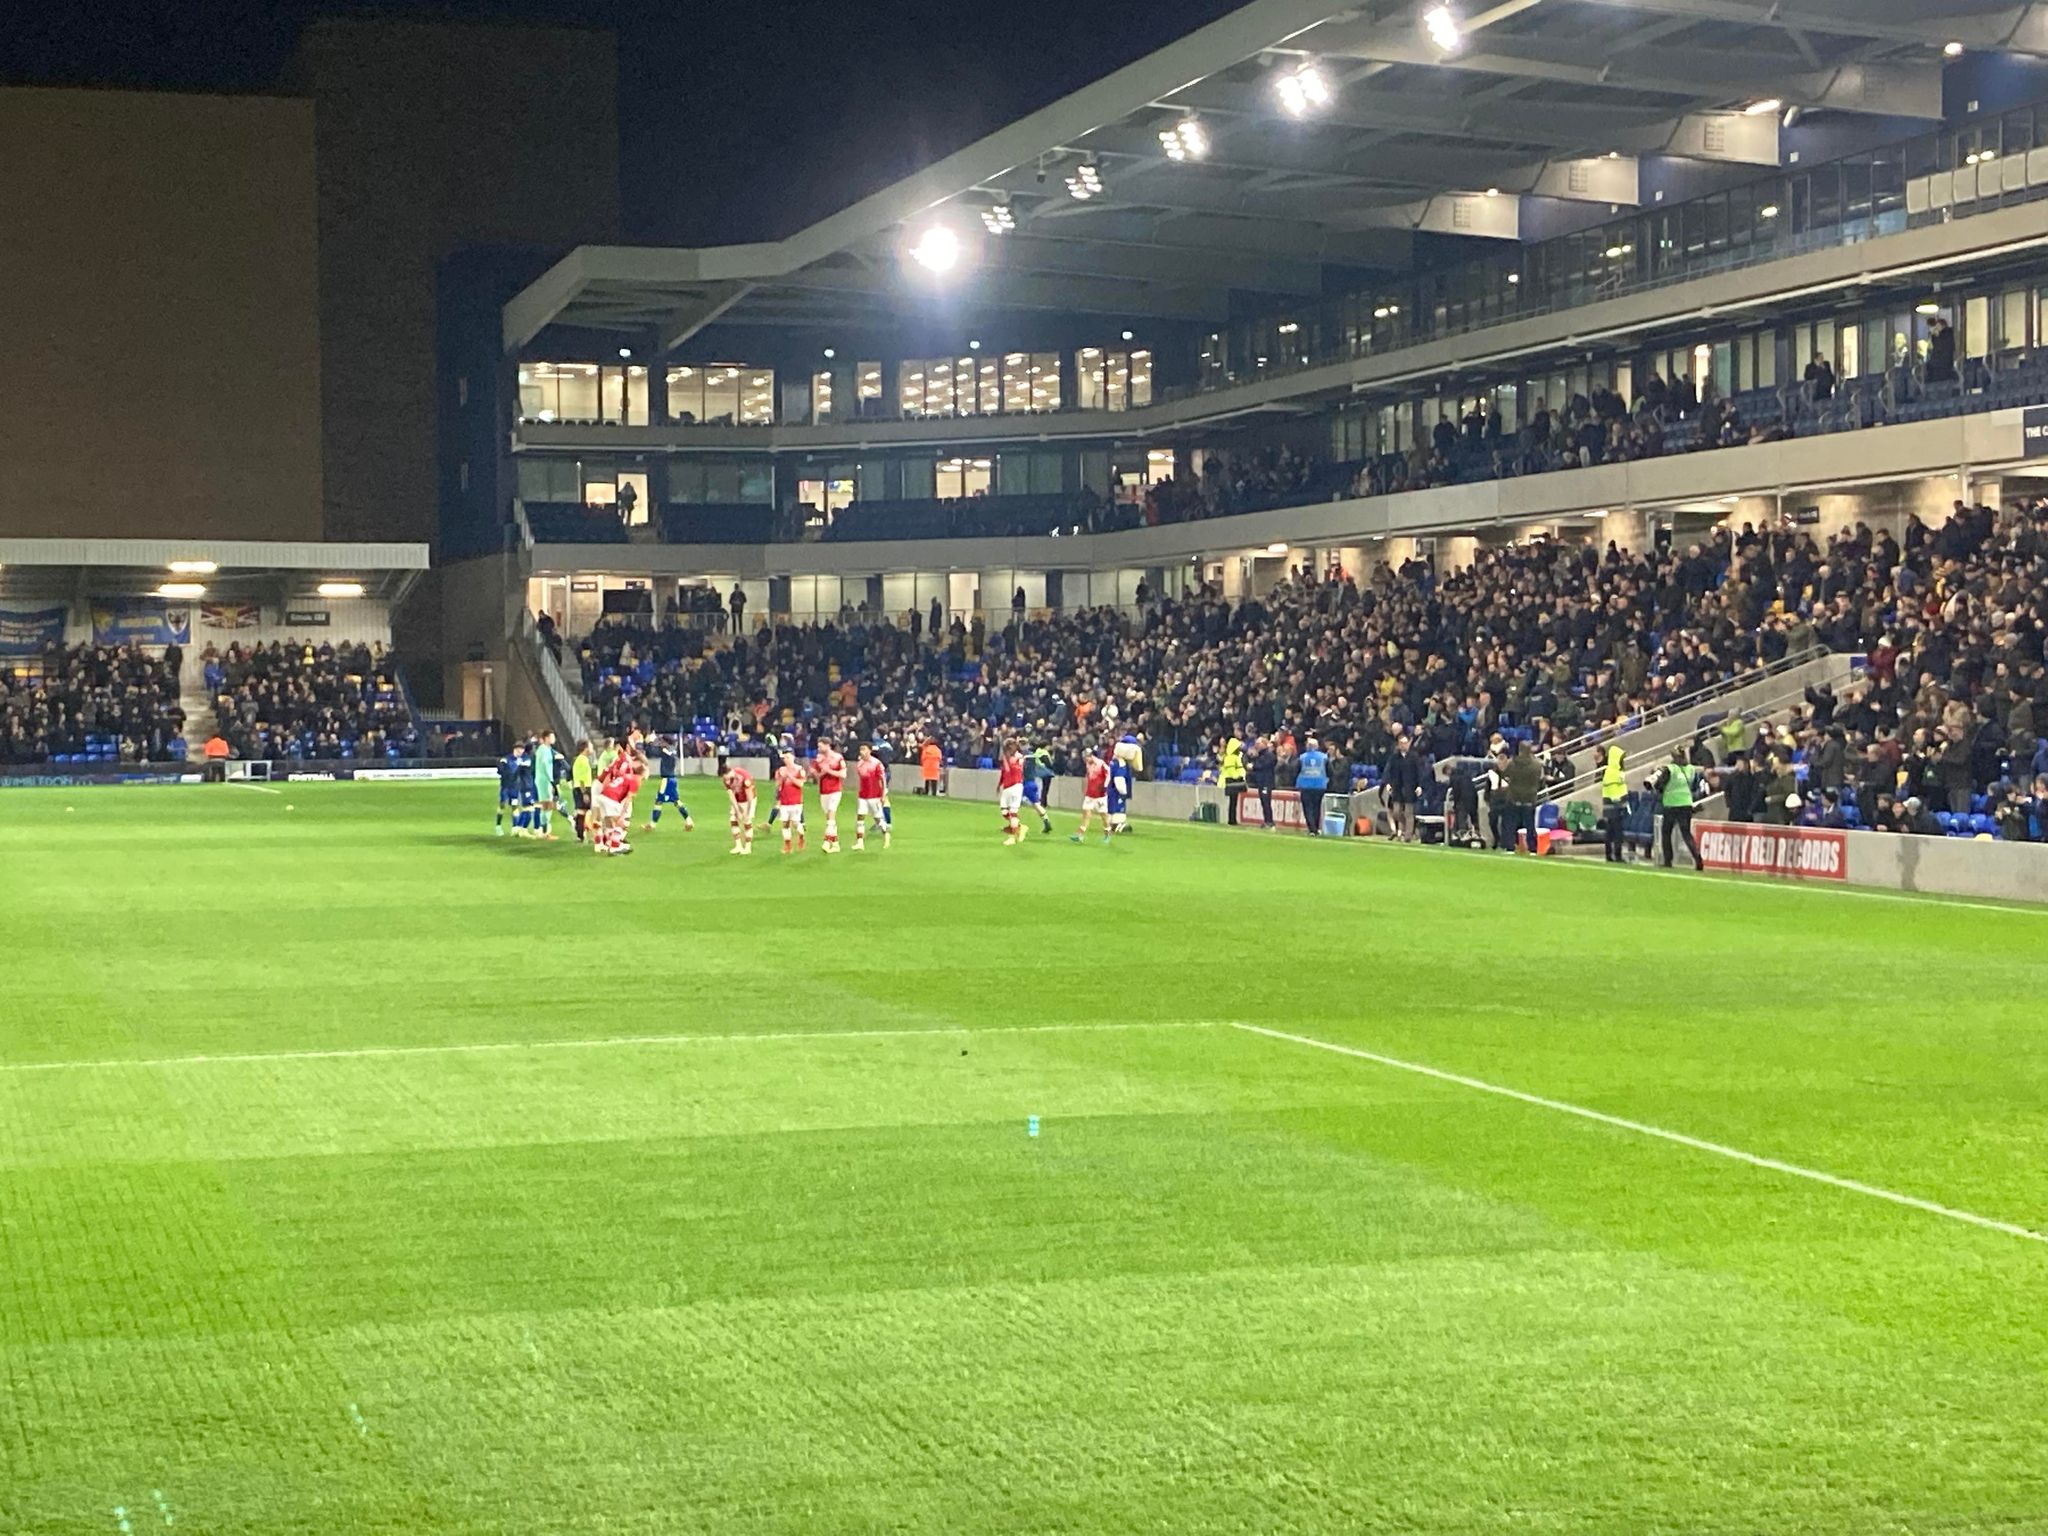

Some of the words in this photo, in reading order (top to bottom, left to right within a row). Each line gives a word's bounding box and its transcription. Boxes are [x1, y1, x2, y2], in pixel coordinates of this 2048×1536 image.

[2025, 426, 2041, 438] THE
[1700, 831, 1749, 864] CHERRY
[1751, 835, 1776, 866] RED
[1777, 837, 1840, 873] RECORDS
